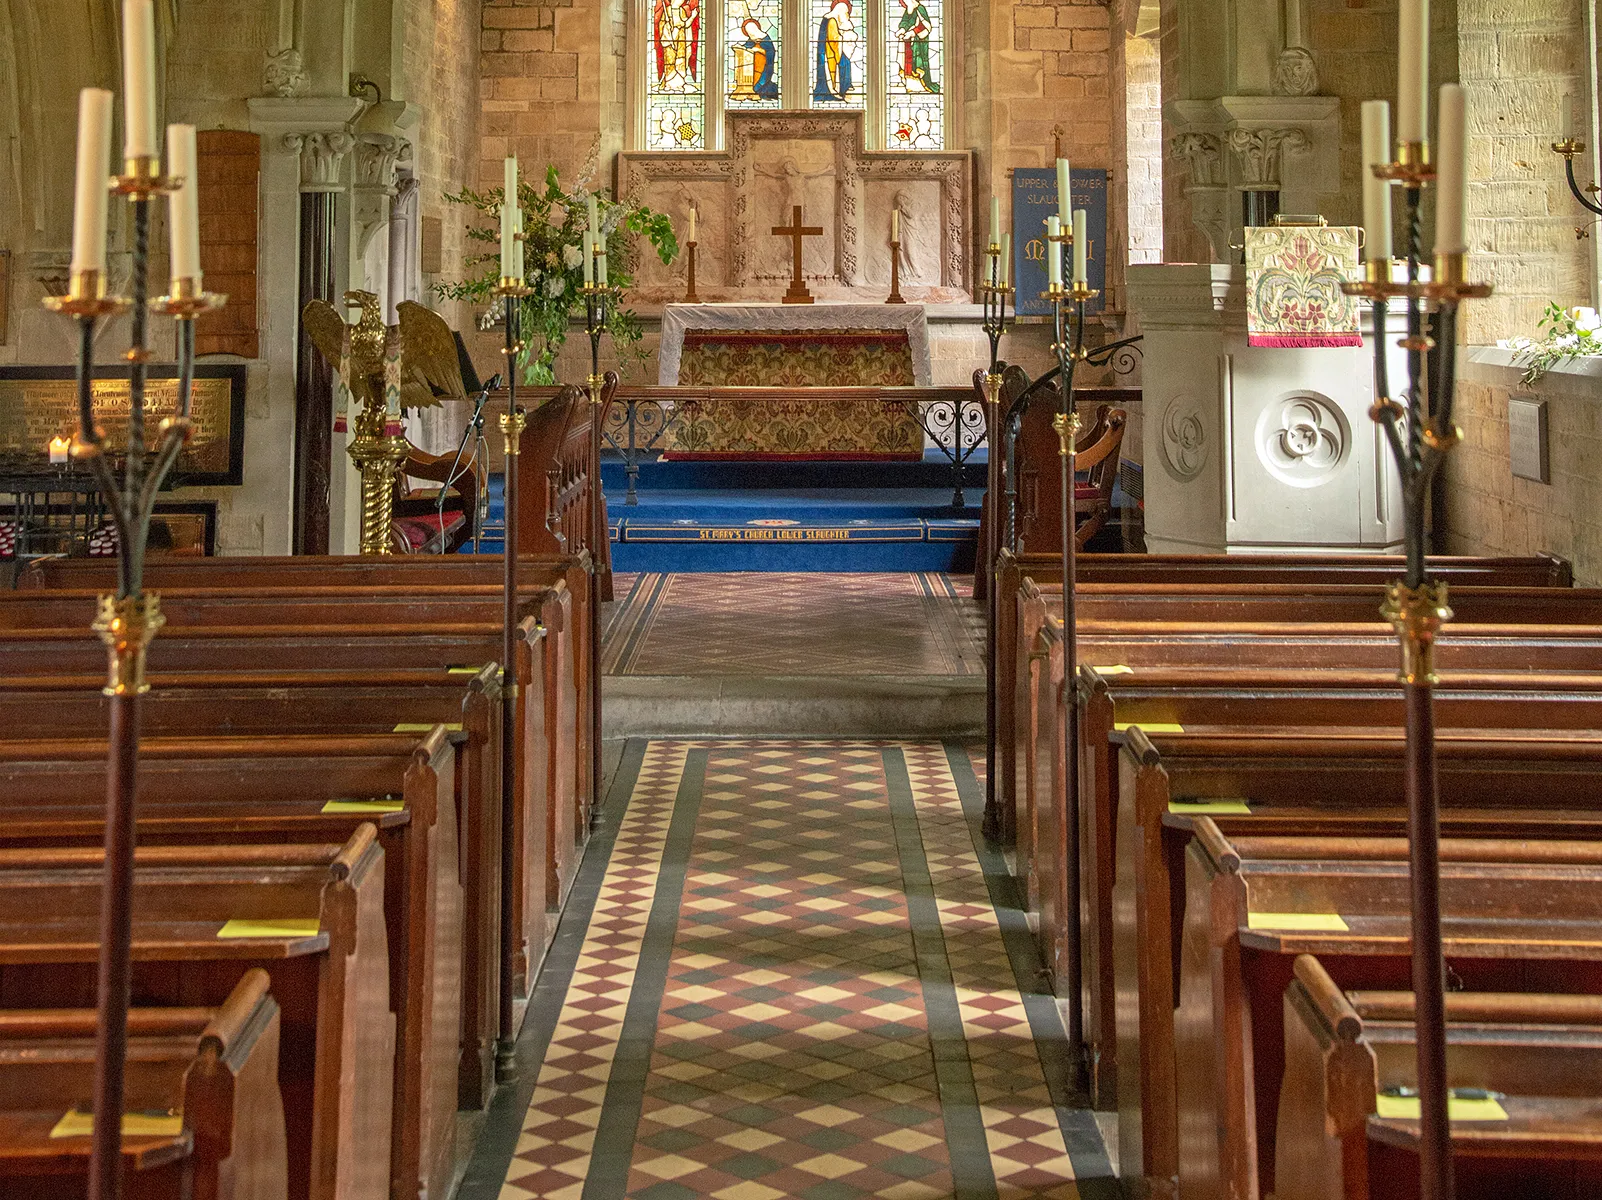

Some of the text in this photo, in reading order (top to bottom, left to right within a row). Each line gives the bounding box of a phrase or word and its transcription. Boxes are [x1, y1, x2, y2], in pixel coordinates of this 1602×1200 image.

[1016, 178, 1049, 189] UPPER
[1071, 178, 1104, 189] OWER
[1027, 194, 1093, 205] SLAUGTER
[700, 530, 850, 539] ST MARY'S CHURCH LOWER SLAUGHTER
